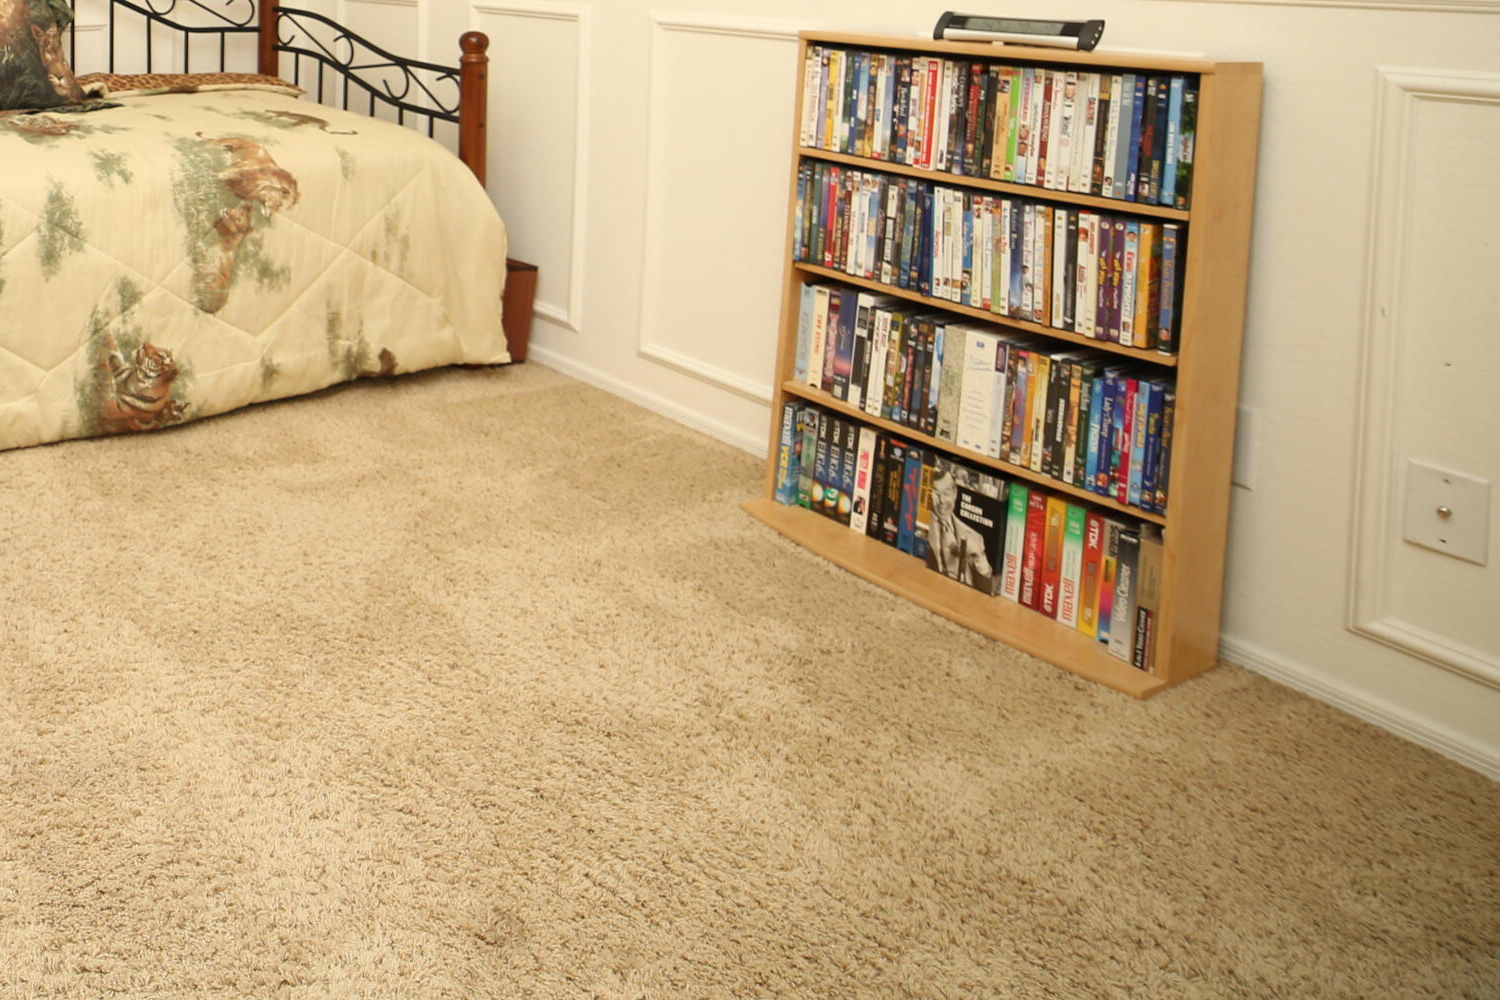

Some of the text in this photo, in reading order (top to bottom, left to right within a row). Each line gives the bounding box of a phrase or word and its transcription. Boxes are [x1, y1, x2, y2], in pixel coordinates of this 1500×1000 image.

[960, 509, 994, 528] COLLECTION
[961, 493, 972, 504] THE
[1004, 553, 1018, 595] maxell
[1115, 563, 1131, 622] Video Cleaner
[1060, 577, 1076, 622] maxell
